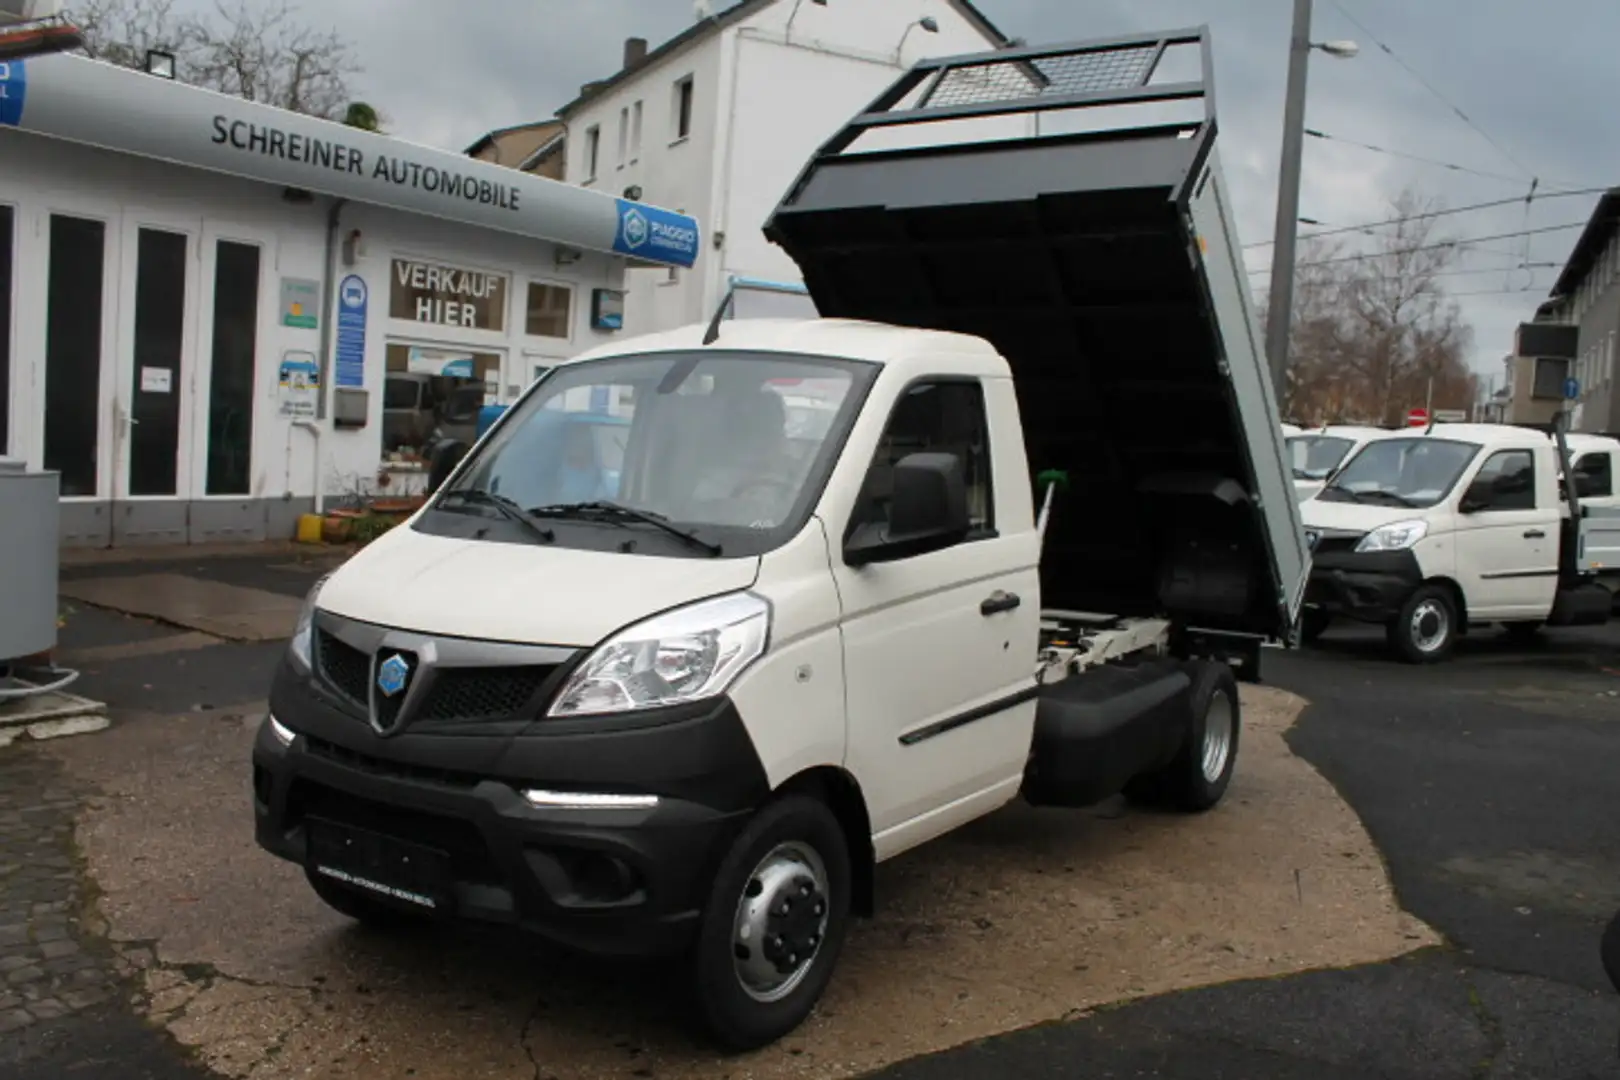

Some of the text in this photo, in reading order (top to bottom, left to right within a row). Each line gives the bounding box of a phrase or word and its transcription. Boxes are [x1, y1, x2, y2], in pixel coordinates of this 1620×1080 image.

[211, 115, 520, 211] SCHREINER AUTOMOBILE
[396, 260, 498, 299] VERKAUF
[416, 296, 477, 328] HIER
